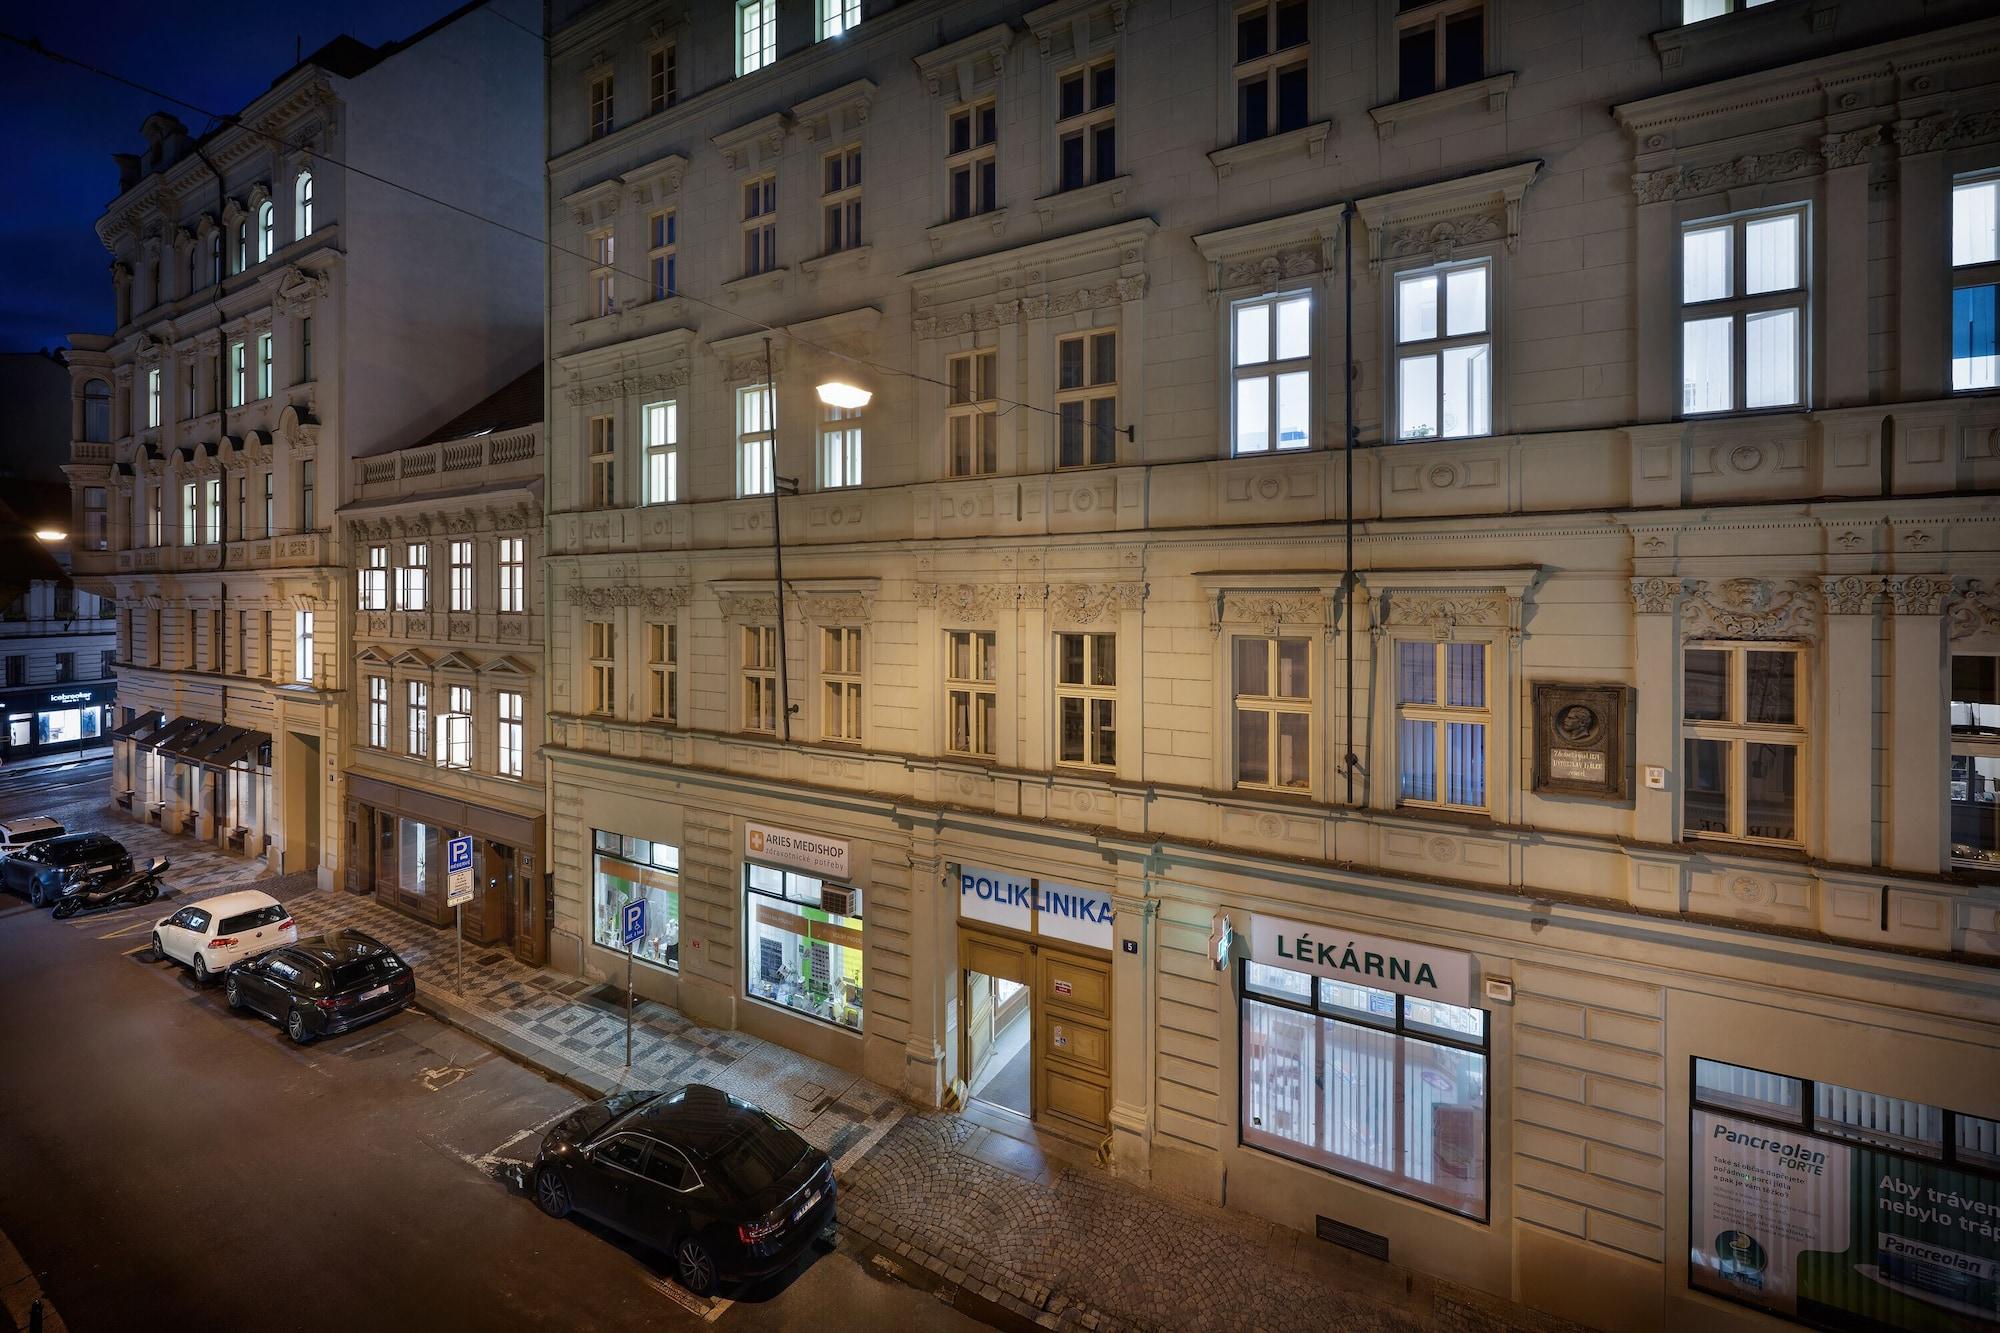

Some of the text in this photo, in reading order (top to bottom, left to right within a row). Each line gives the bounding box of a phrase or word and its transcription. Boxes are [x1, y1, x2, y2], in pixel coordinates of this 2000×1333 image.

[453, 842, 467, 862] P
[766, 834, 844, 858] ARIES MEDISHOP
[765, 848, 844, 871] zdravotnické potřeby
[962, 874, 1116, 926] POLIKLINIKA
[628, 907, 641, 931] P
[1127, 942, 1133, 951] 5
[1278, 933, 1438, 989] LÉKÁRNA
[1714, 1124, 1825, 1165] Pancreolan
[1779, 1157, 1824, 1176] FORTE
[1720, 1175, 1734, 1185] pak
[1735, 1179, 1743, 1187] je
[1880, 1175, 1920, 1200] Aby
[1880, 1197, 1952, 1226] nebylo
[1885, 1236, 1981, 1274] Pancreolan
